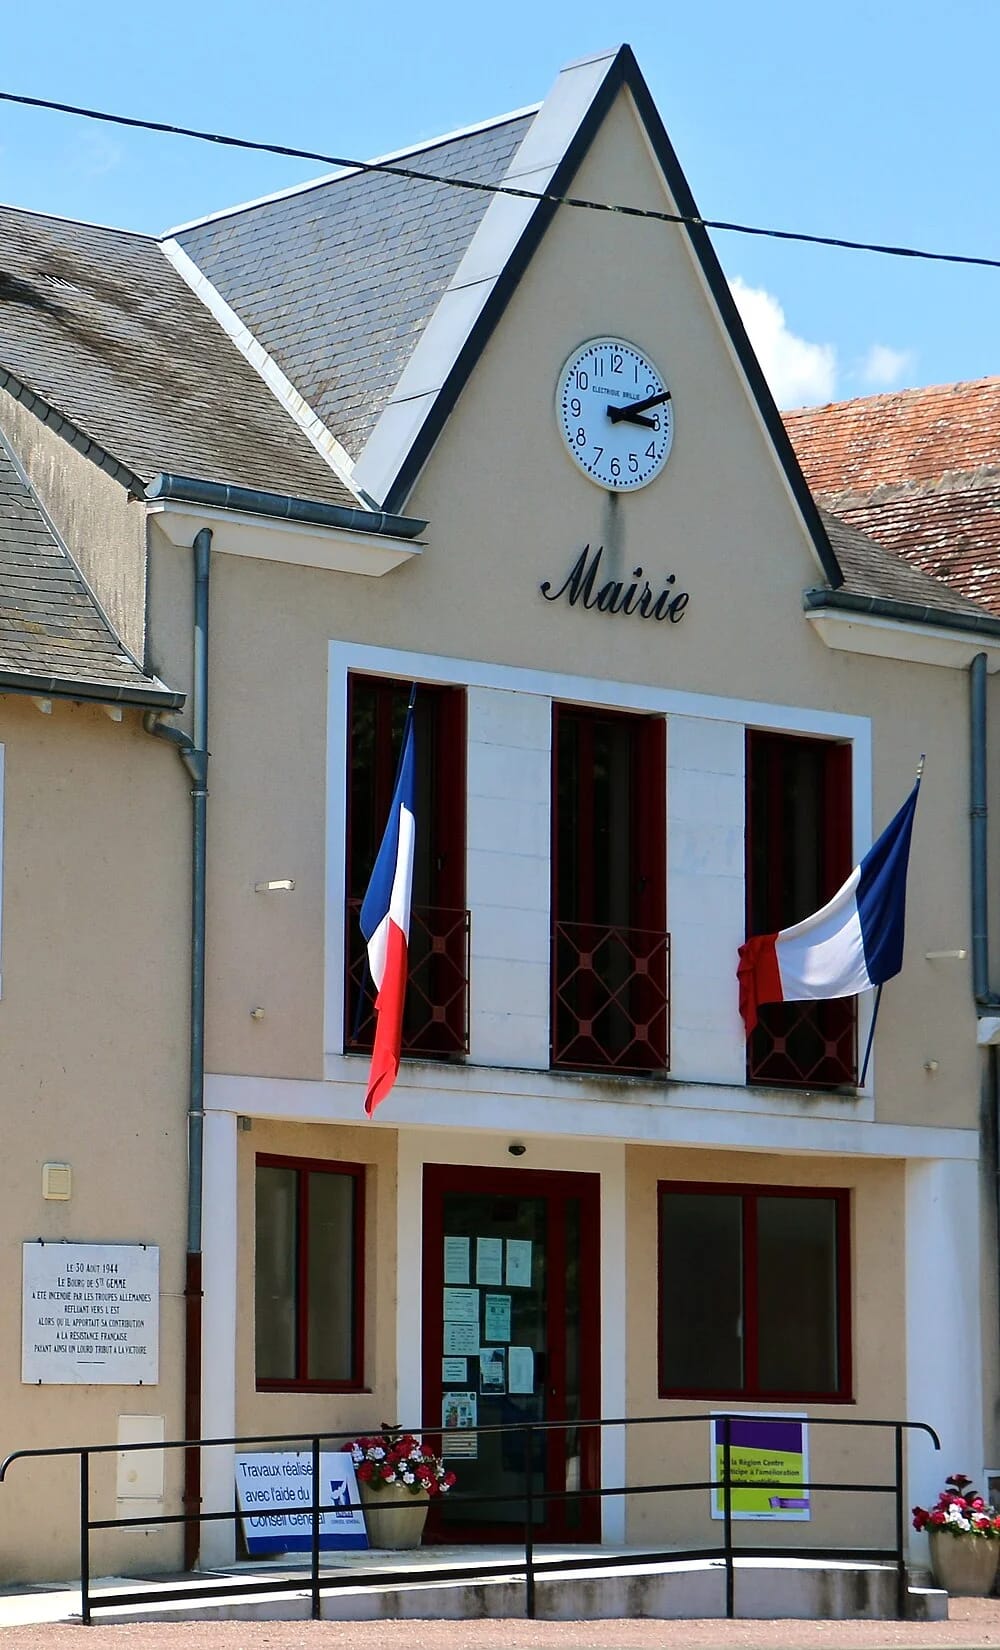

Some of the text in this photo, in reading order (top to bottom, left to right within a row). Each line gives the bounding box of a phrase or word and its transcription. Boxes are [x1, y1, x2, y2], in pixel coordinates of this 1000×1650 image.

[594, 357, 603, 377] 11
[611, 354, 623, 373] 12
[576, 371, 589, 390] 10
[634, 365, 638, 383] 1
[645, 384, 656, 399] 2
[570, 399, 581, 417] 9
[652, 413, 661, 431] 3
[575, 428, 586, 446] 8
[593, 447, 604, 466] 7
[645, 441, 656, 459] 4
[610, 458, 621, 476] 6
[628, 454, 638, 472] 5
[540, 543, 690, 624] Mairie
[76, 1262, 84, 1273] 30
[103, 1264, 118, 1273] 1944
[106, 1279, 126, 1288] GEMME
[73, 1292, 83, 1301] PAR
[84, 1293, 94, 1301] LES
[95, 1293, 118, 1301] TROUPES
[119, 1293, 152, 1302] ALLEMANDES
[91, 1305, 104, 1314] VERS
[38, 1317, 55, 1326] ALORS
[72, 1318, 100, 1327] APPORTAIT
[101, 1319, 108, 1328] SA
[109, 1319, 145, 1328] CONTRIBUTION
[61, 1331, 68, 1340] LA
[34, 1344, 52, 1353] PAYANT
[53, 1345, 67, 1353] AINSI
[68, 1345, 76, 1353] UN
[77, 1345, 94, 1354] LOURD
[95, 1345, 113, 1354] TRIBUT
[118, 1346, 125, 1354] LA
[125, 1346, 147, 1355] VICTOIRE
[239, 1461, 313, 1477] Travaux réalisé
[245, 1486, 310, 1503] avec l'aide du
